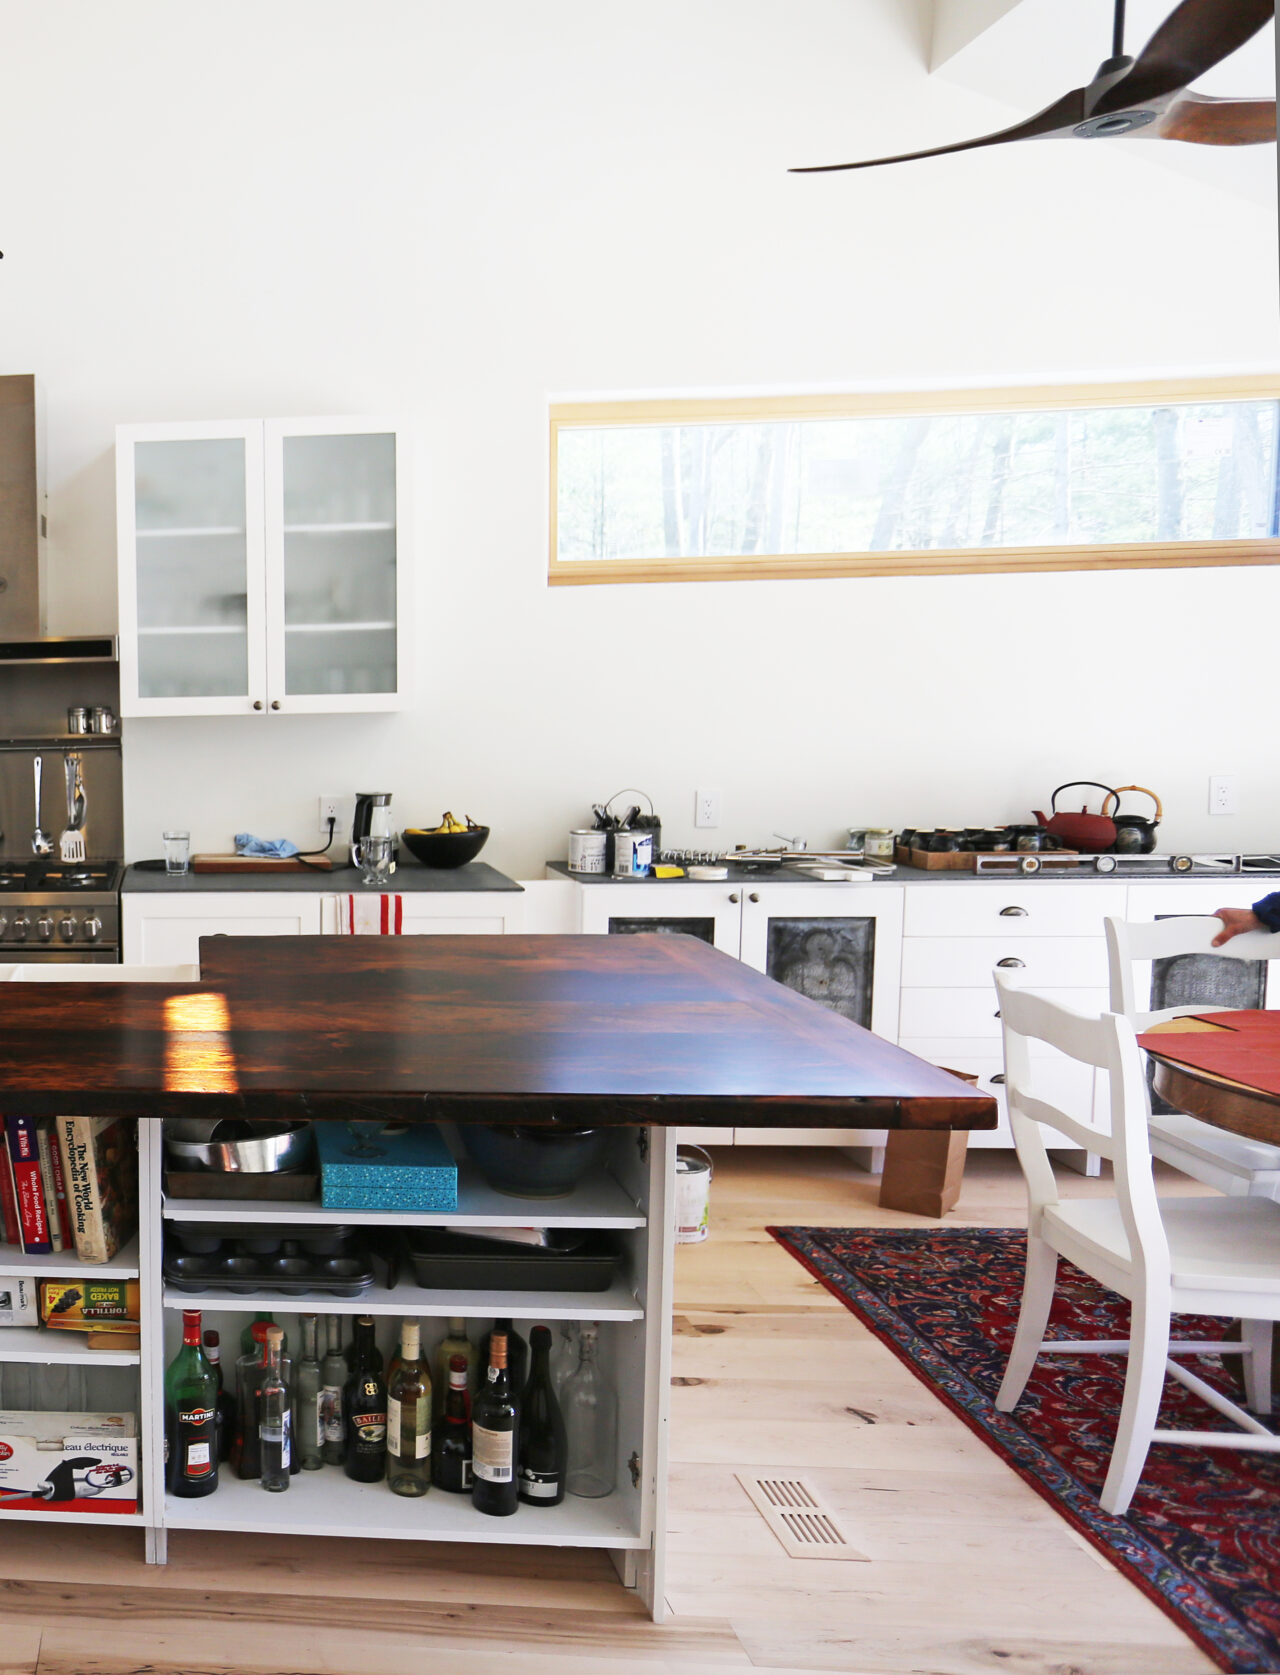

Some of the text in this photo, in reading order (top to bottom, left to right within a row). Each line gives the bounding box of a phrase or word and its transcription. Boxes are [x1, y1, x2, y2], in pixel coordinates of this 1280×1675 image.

[65, 1120, 86, 1234] Encyclopedia of Cooking
[77, 1142, 94, 1211] The New World
[30, 1170, 38, 1193] Whole
[34, 1211, 43, 1235] Recipes
[47, 1295, 56, 1304] 4
[90, 1293, 119, 1301] BAKED
[181, 1411, 214, 1422] MARTINI
[83, 1442, 129, 1453] électrique
